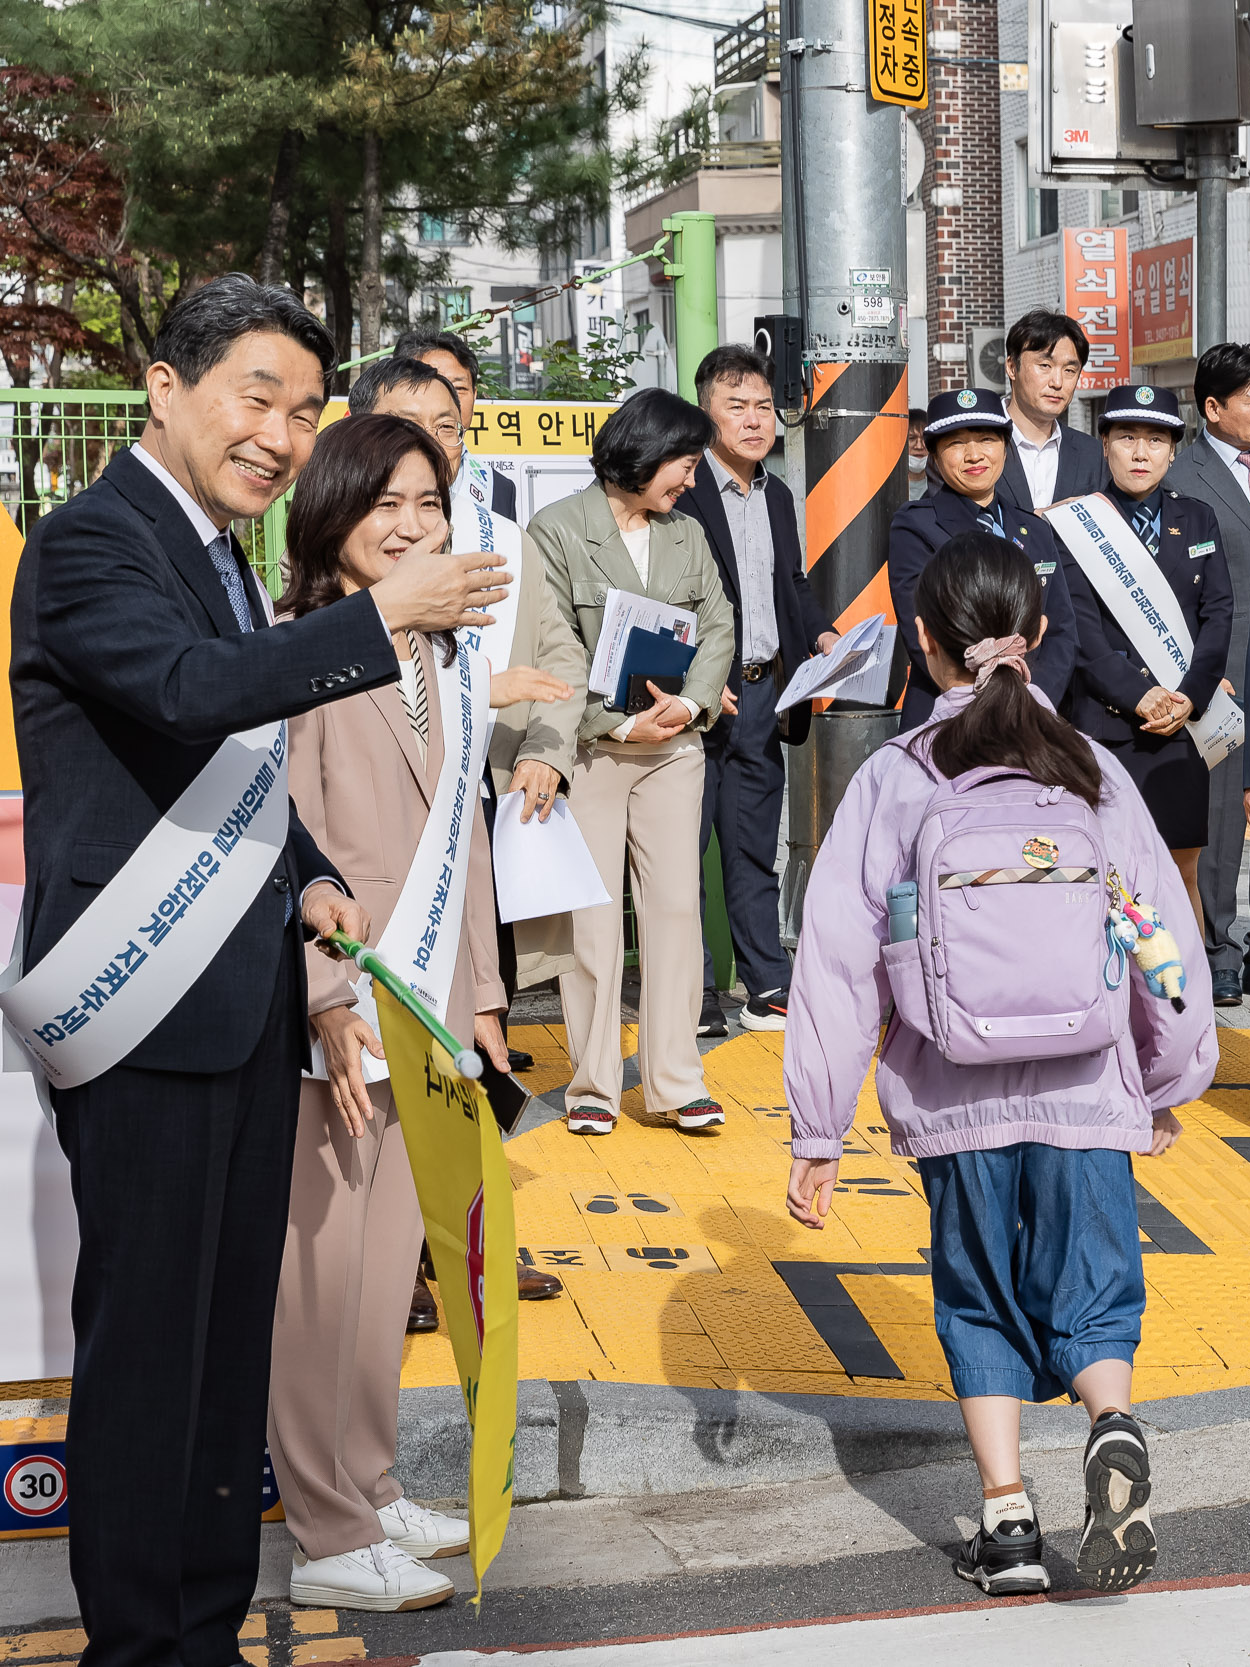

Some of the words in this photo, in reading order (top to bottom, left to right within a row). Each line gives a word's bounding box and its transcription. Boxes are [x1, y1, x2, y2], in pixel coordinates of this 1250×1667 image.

[1063, 129, 1089, 143] 3M
[863, 296, 883, 308] 598
[1075, 230, 1120, 373] 열쇠전문
[538, 410, 613, 447] 안내
[1069, 502, 1106, 544] 아이들의
[1098, 540, 1137, 590] 등하굣길
[1130, 586, 1170, 638] 안전하게
[212, 760, 277, 857] 등하굣길
[445, 776, 468, 863] 안전하게
[137, 850, 222, 948] 안전하게
[412, 862, 454, 973] 지켜주세요
[32, 939, 149, 1048] 지켜주세요
[19, 1472, 58, 1500] 30
